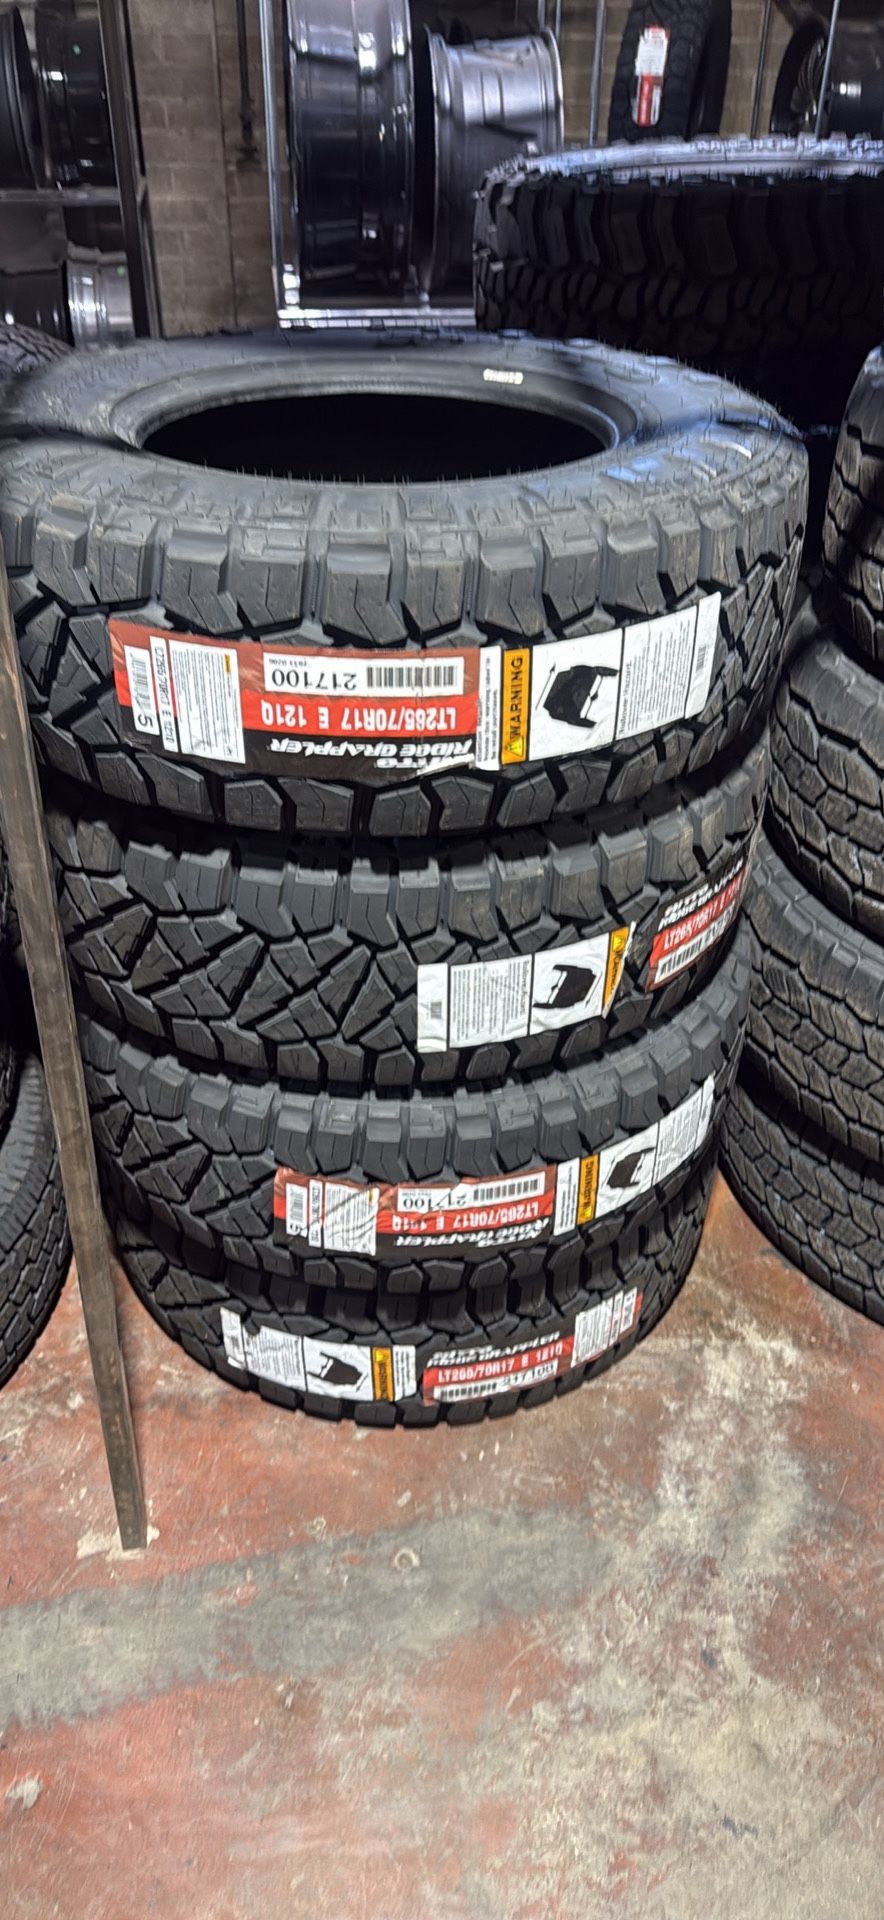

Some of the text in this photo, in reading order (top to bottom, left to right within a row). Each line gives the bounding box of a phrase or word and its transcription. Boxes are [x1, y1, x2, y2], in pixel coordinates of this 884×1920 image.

[271, 669, 357, 691] 217100
[509, 657, 523, 740] WARNING
[138, 715, 154, 728] 5
[261, 699, 306, 727] 121Q
[318, 707, 329, 728] E
[341, 706, 456, 731] LT265/70R17
[270, 738, 472, 757] RIDGE GRAPPLER
[437, 1216, 445, 1230] E
[453, 1201, 538, 1228] LT265/70R17
[396, 1230, 494, 1247] GRAPPLER
[476, 1230, 542, 1247] NITTO
[522, 1355, 529, 1368] E
